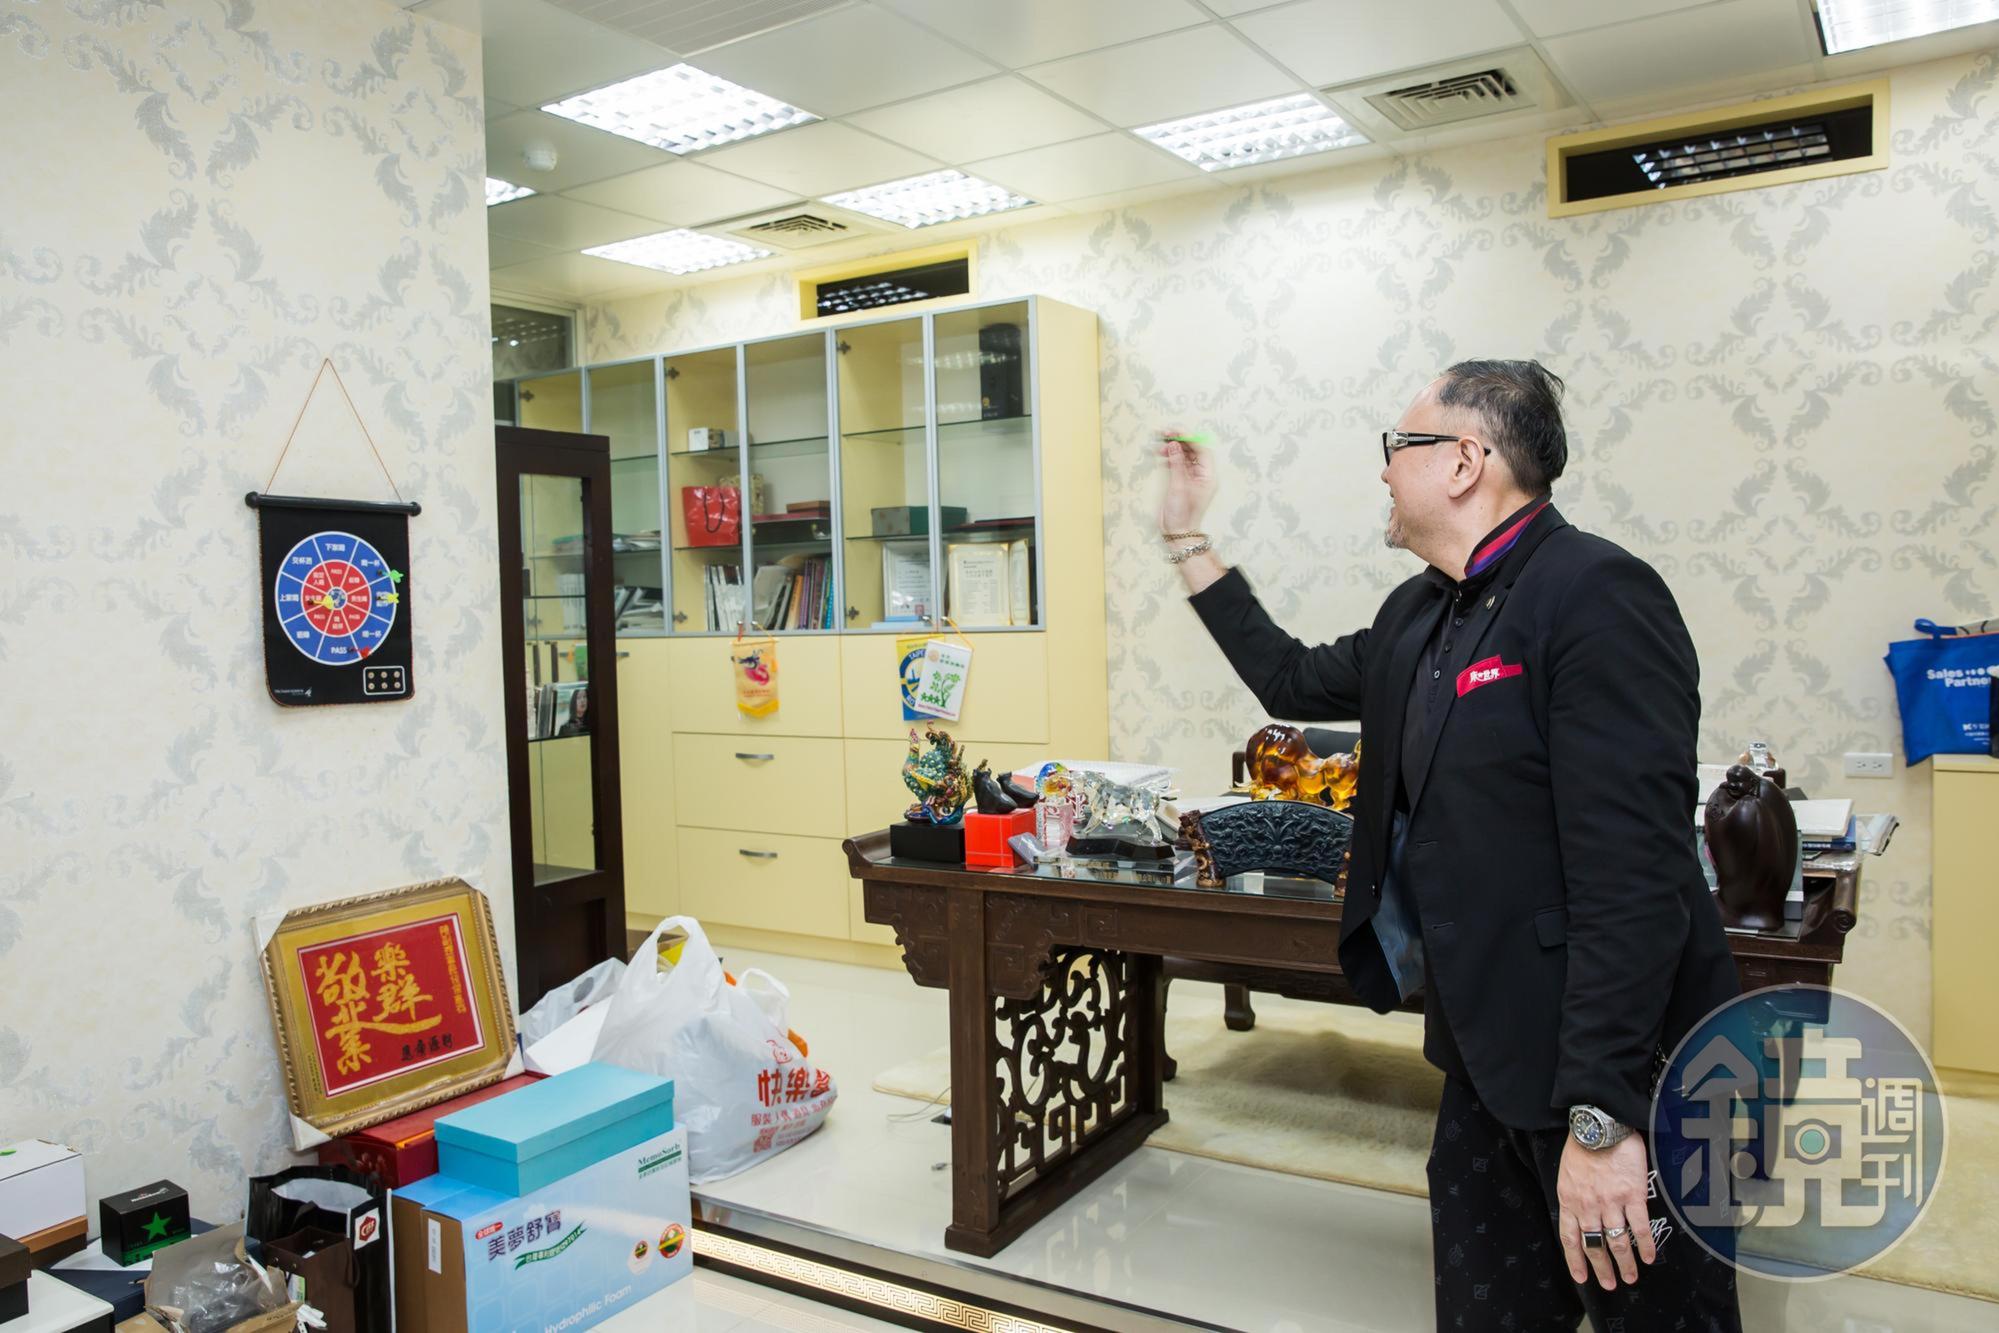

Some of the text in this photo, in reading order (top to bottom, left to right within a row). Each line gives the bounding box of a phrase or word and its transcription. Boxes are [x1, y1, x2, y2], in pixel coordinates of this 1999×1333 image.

[331, 646, 347, 655] PASS
[1926, 668, 1964, 680] Sales
[487, 1209, 561, 1262] 美夢舒寶
[604, 1284, 632, 1305] Foam
